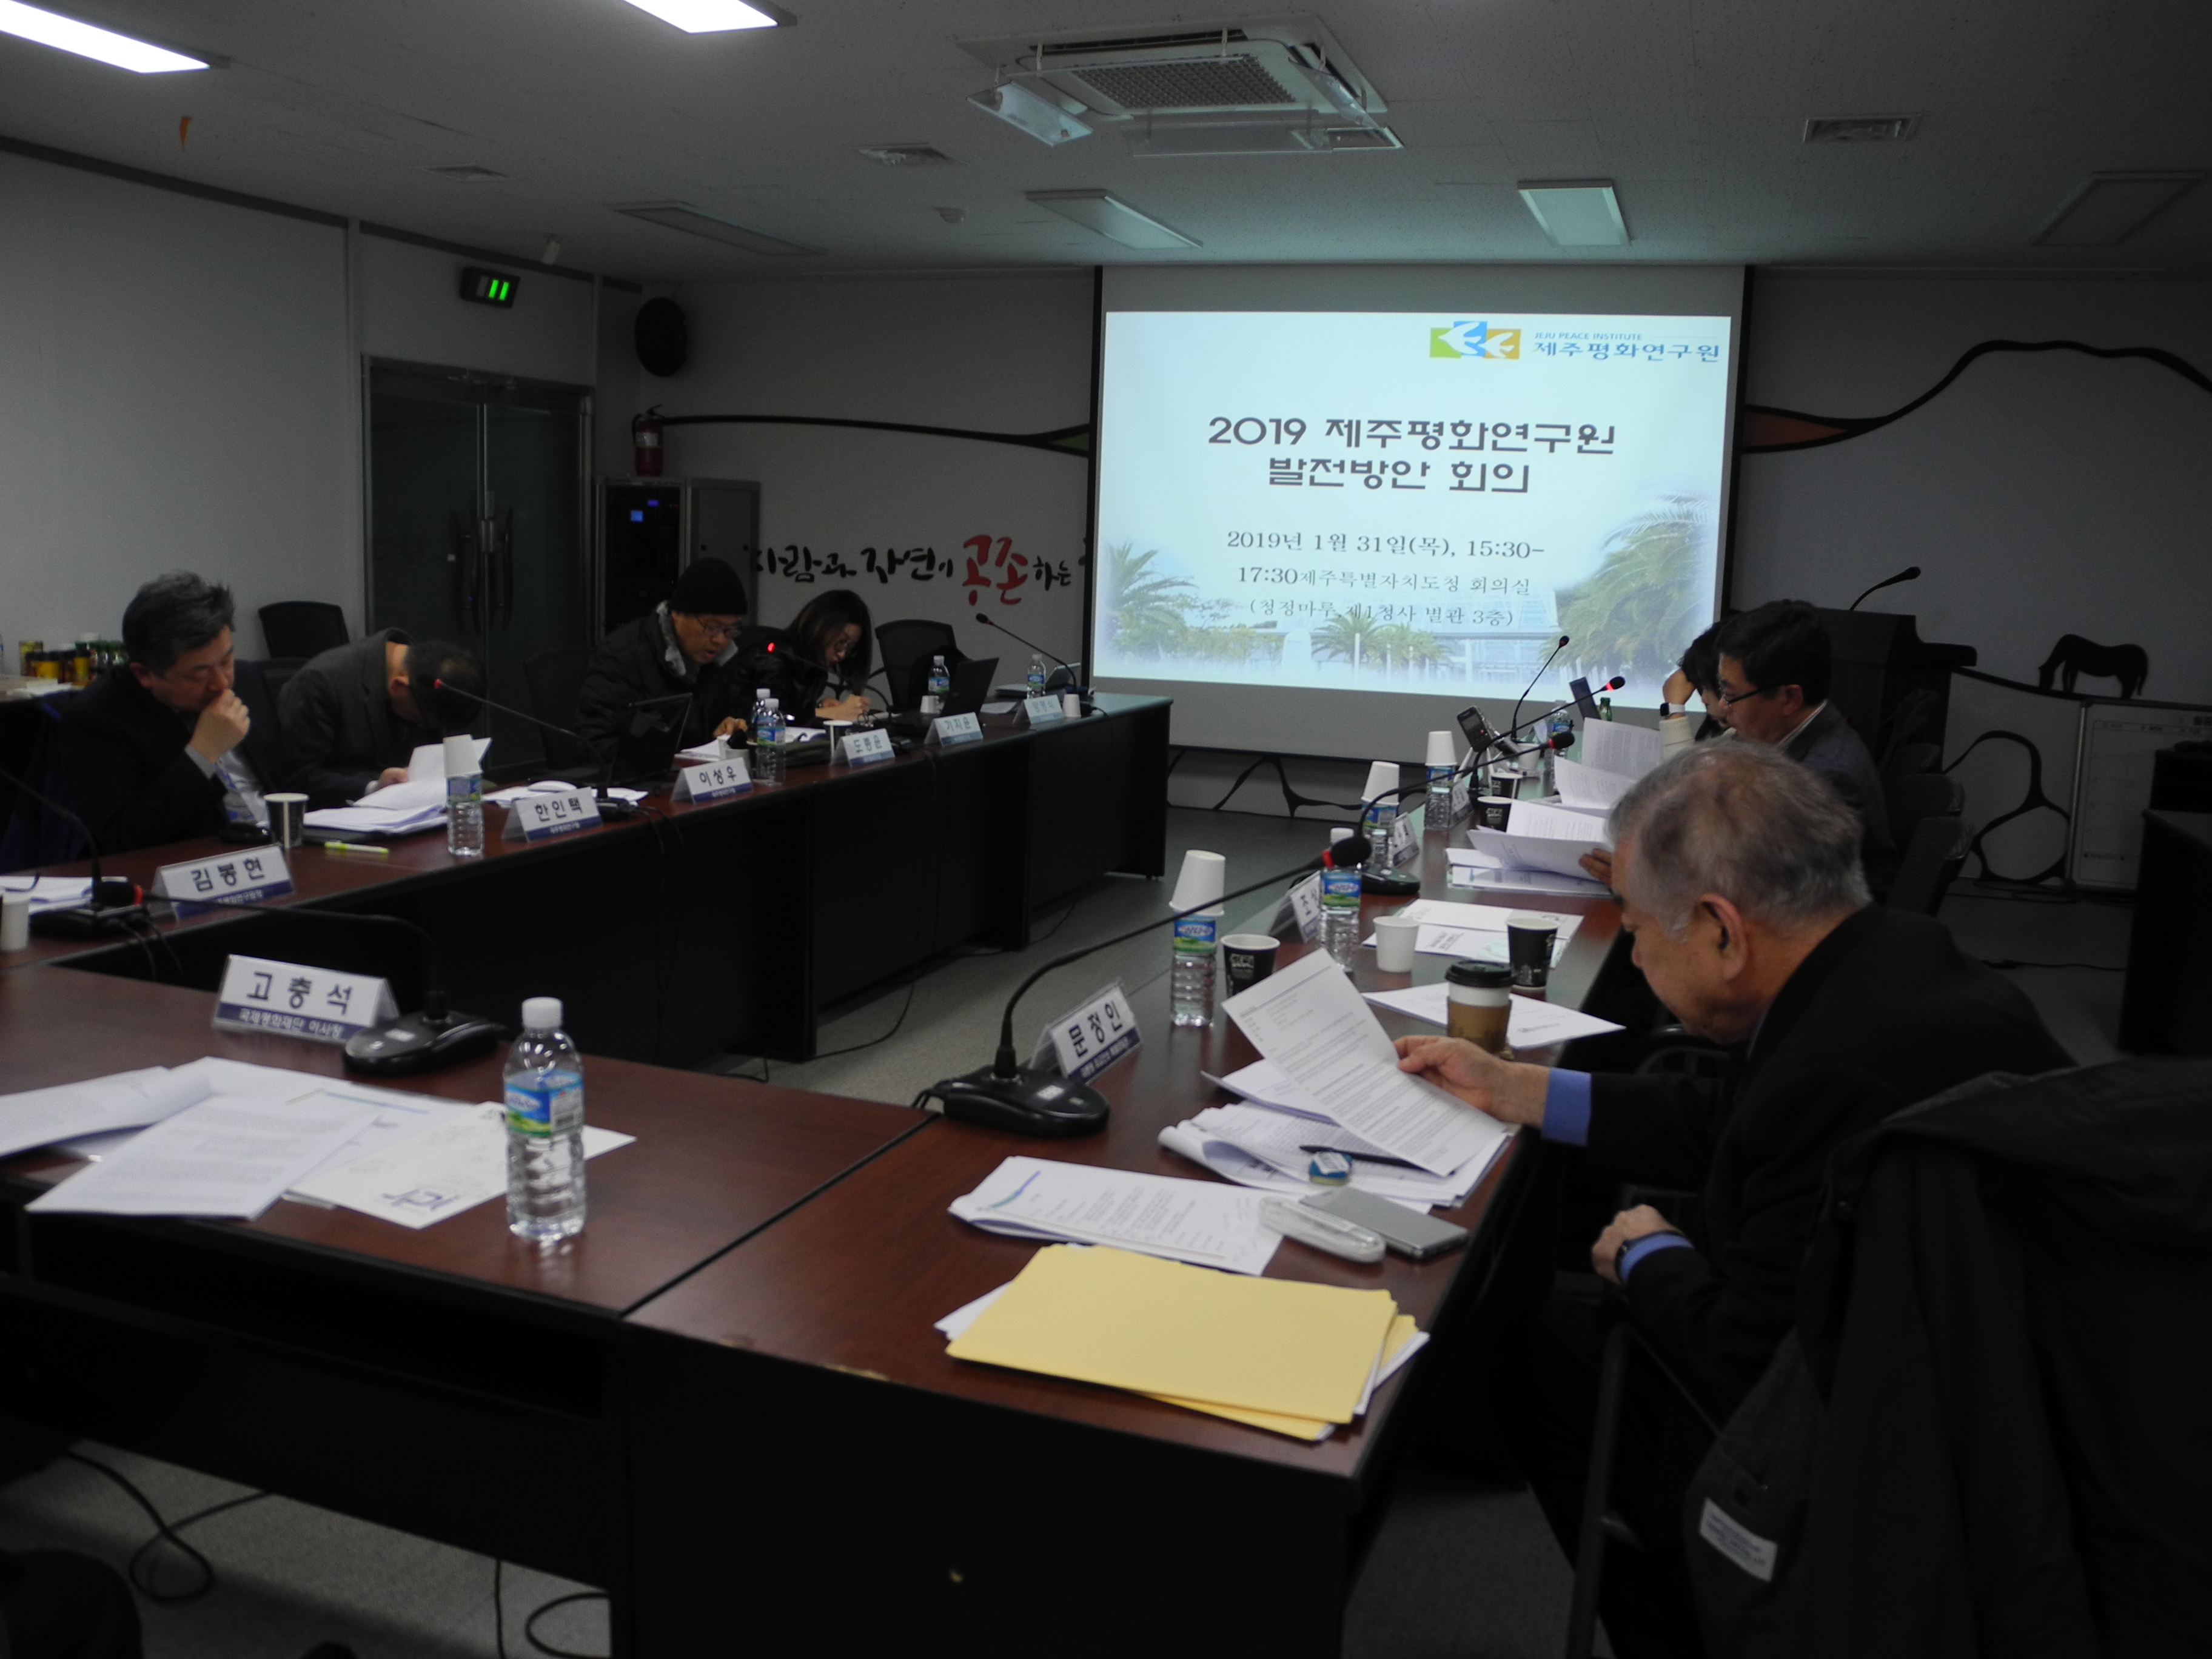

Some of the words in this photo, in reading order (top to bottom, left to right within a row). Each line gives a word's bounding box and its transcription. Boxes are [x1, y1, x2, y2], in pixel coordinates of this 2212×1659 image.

[1534, 341, 1720, 363] 제주평화연구원
[1208, 416, 1307, 446] 2019
[1324, 418, 1616, 455] 제주평화연구원
[1268, 457, 1431, 491] 발전방안
[1449, 460, 1530, 494] 회의
[1227, 530, 1303, 551] 2019년
[1313, 532, 1347, 554] 1월
[1356, 535, 1456, 557] 31일(목),
[860, 546, 954, 584] 자연이
[1469, 577, 1531, 597] 회의실
[1425, 608, 1464, 625] 별관
[1472, 609, 1514, 627] 3층)
[699, 765, 737, 786] 이성우
[534, 796, 584, 823] 한인택
[190, 857, 266, 892] 김봉현
[246, 971, 352, 1016] 고충석
[308, 1019, 344, 1039] 이사장
[1068, 999, 1123, 1058] 문정인
